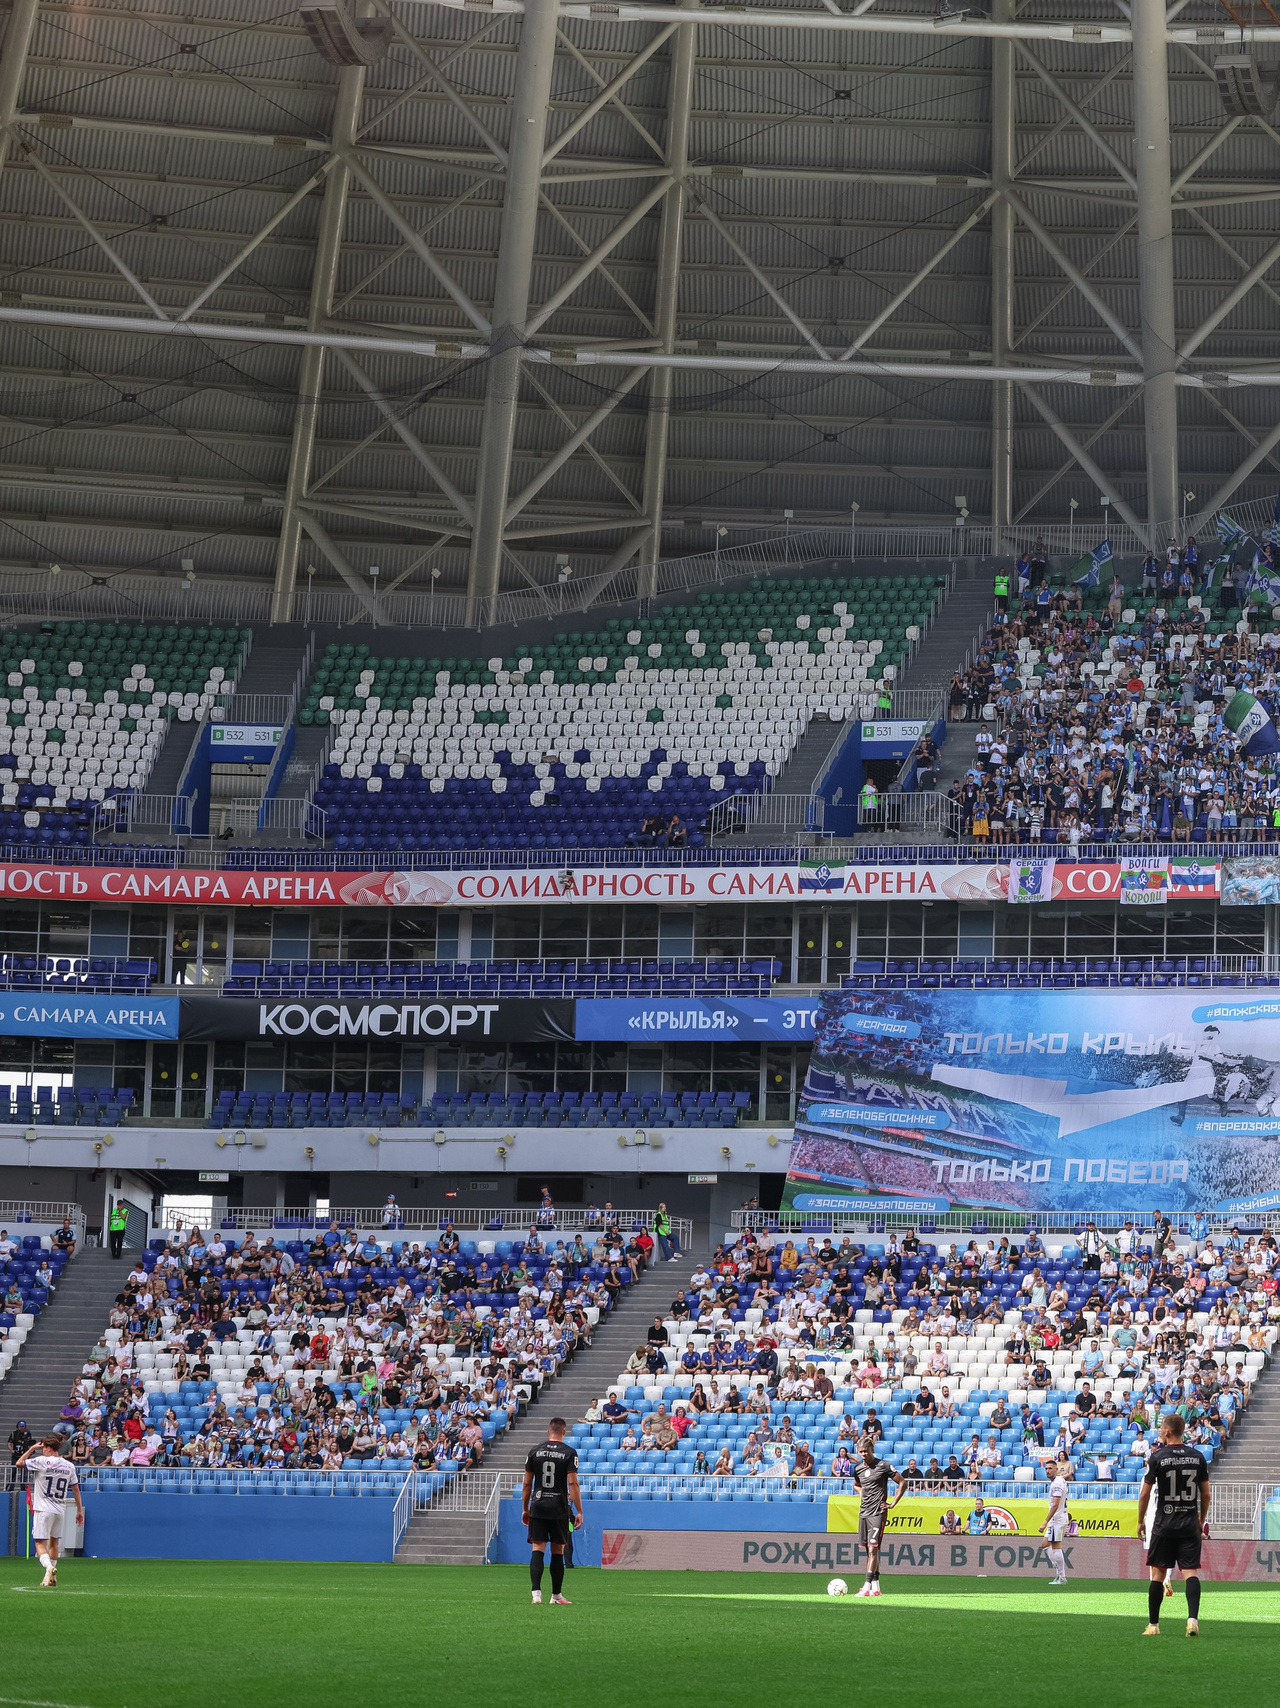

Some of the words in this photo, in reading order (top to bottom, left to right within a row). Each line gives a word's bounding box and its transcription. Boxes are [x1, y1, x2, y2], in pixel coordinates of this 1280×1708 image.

[226, 730, 244, 740] 532
[254, 731, 270, 741] 531
[876, 726, 892, 736] 531
[901, 726, 919, 736] 530
[1128, 858, 1160, 869] ВОЛГИ
[101, 872, 230, 898] САМАРА
[241, 876, 336, 900] АРЕНА
[457, 873, 695, 898] СОЛИДАРНОСТЬ
[708, 872, 832, 895] САМА
[843, 871, 937, 895] АРЕНА
[13, 1006, 98, 1024] САМАРА
[104, 1009, 167, 1026] АРЕНА
[628, 1009, 739, 1030] «КРЫЛЬЯ»
[856, 1018, 908, 1034] #САМАРА
[943, 1032, 1069, 1055] ТОЛЬКО
[931, 1158, 1052, 1184] ТОЛЬКО
[1063, 1158, 1189, 1184] ПОБЕДА
[542, 1461, 556, 1488] 8
[45, 1476, 68, 1499] 19
[1164, 1469, 1198, 1501] 13
[872, 1527, 880, 1538] 7
[1071, 1519, 1120, 1531] АМАРА
[743, 1541, 935, 1570] РОЖДЕННАЯ
[950, 1545, 966, 1567] В
